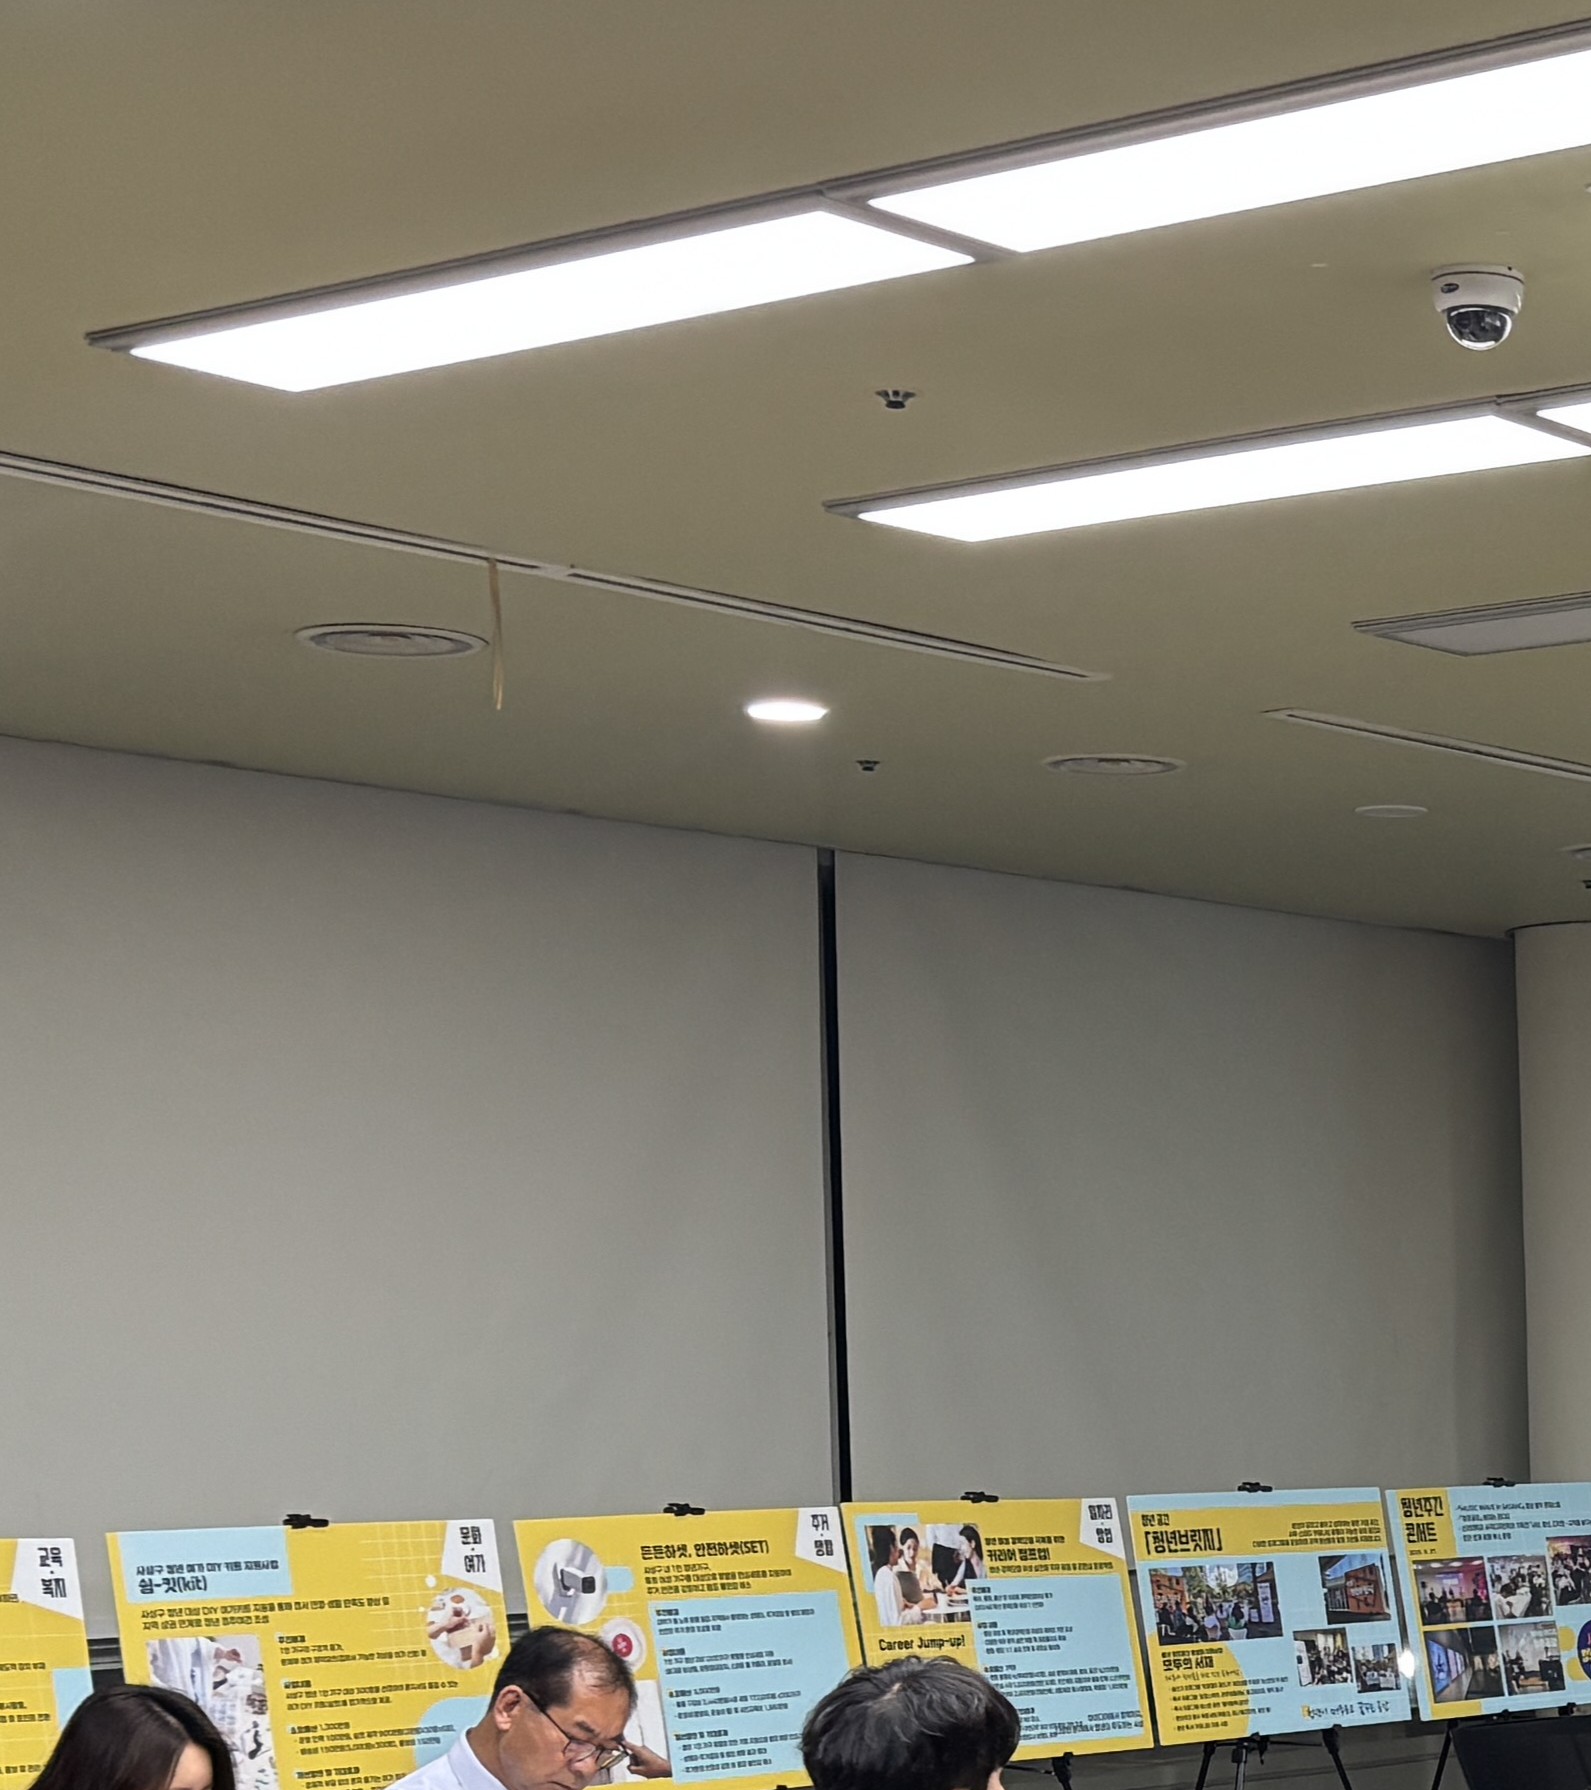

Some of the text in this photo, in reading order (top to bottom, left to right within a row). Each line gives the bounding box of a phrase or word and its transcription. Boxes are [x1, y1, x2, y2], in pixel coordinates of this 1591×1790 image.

[1400, 1496, 1444, 1518] 청년주간
[811, 1514, 829, 1531] 주거
[459, 1526, 482, 1545] 문화
[1405, 1522, 1438, 1543] 콘서트
[37, 1547, 63, 1567] 교육
[464, 1554, 486, 1573] 여가
[986, 1548, 1017, 1561] 커리어
[41, 1577, 67, 1598] 복지
[138, 1575, 208, 1595] 쉼-킷(kit)
[878, 1634, 965, 1651] Career Jump-up!
[1162, 1656, 1214, 1671] 모두의 서재
